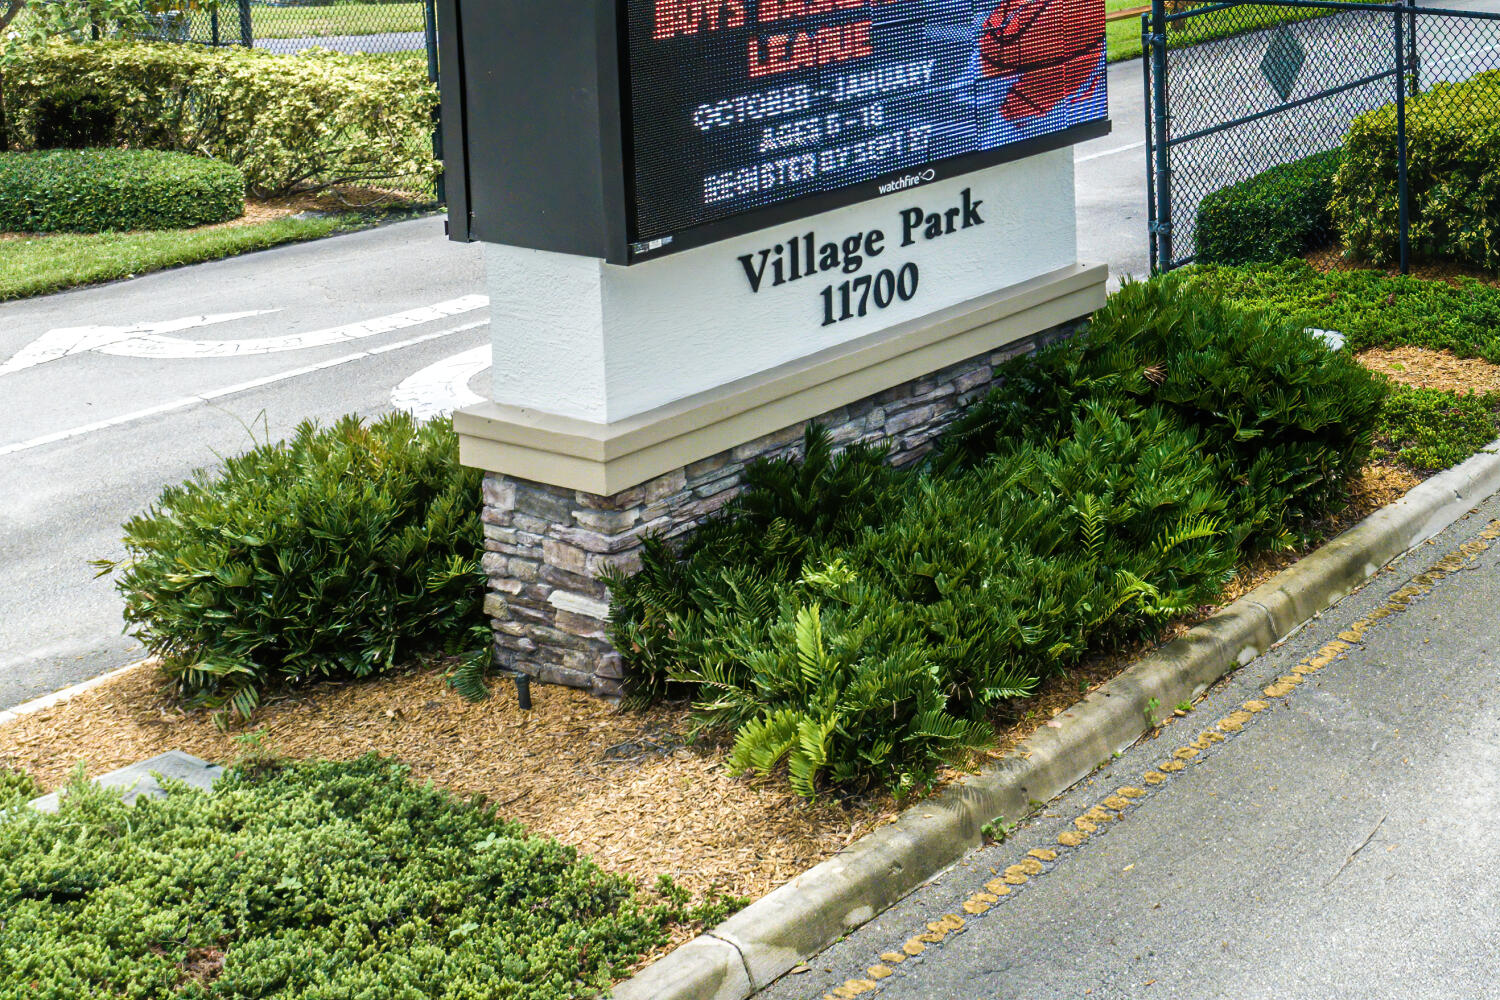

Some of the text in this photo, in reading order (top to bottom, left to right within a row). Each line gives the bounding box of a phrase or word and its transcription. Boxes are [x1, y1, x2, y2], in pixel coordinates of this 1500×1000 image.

[748, 21, 874, 78] LEAGUE
[693, 84, 811, 131] OCTOBER
[832, 59, 936, 102] JANUARY
[759, 117, 821, 153] AGES
[703, 152, 817, 204] REGISTER
[879, 174, 920, 195] watchfire
[738, 187, 985, 294] Village Park
[819, 261, 920, 328] 11700
